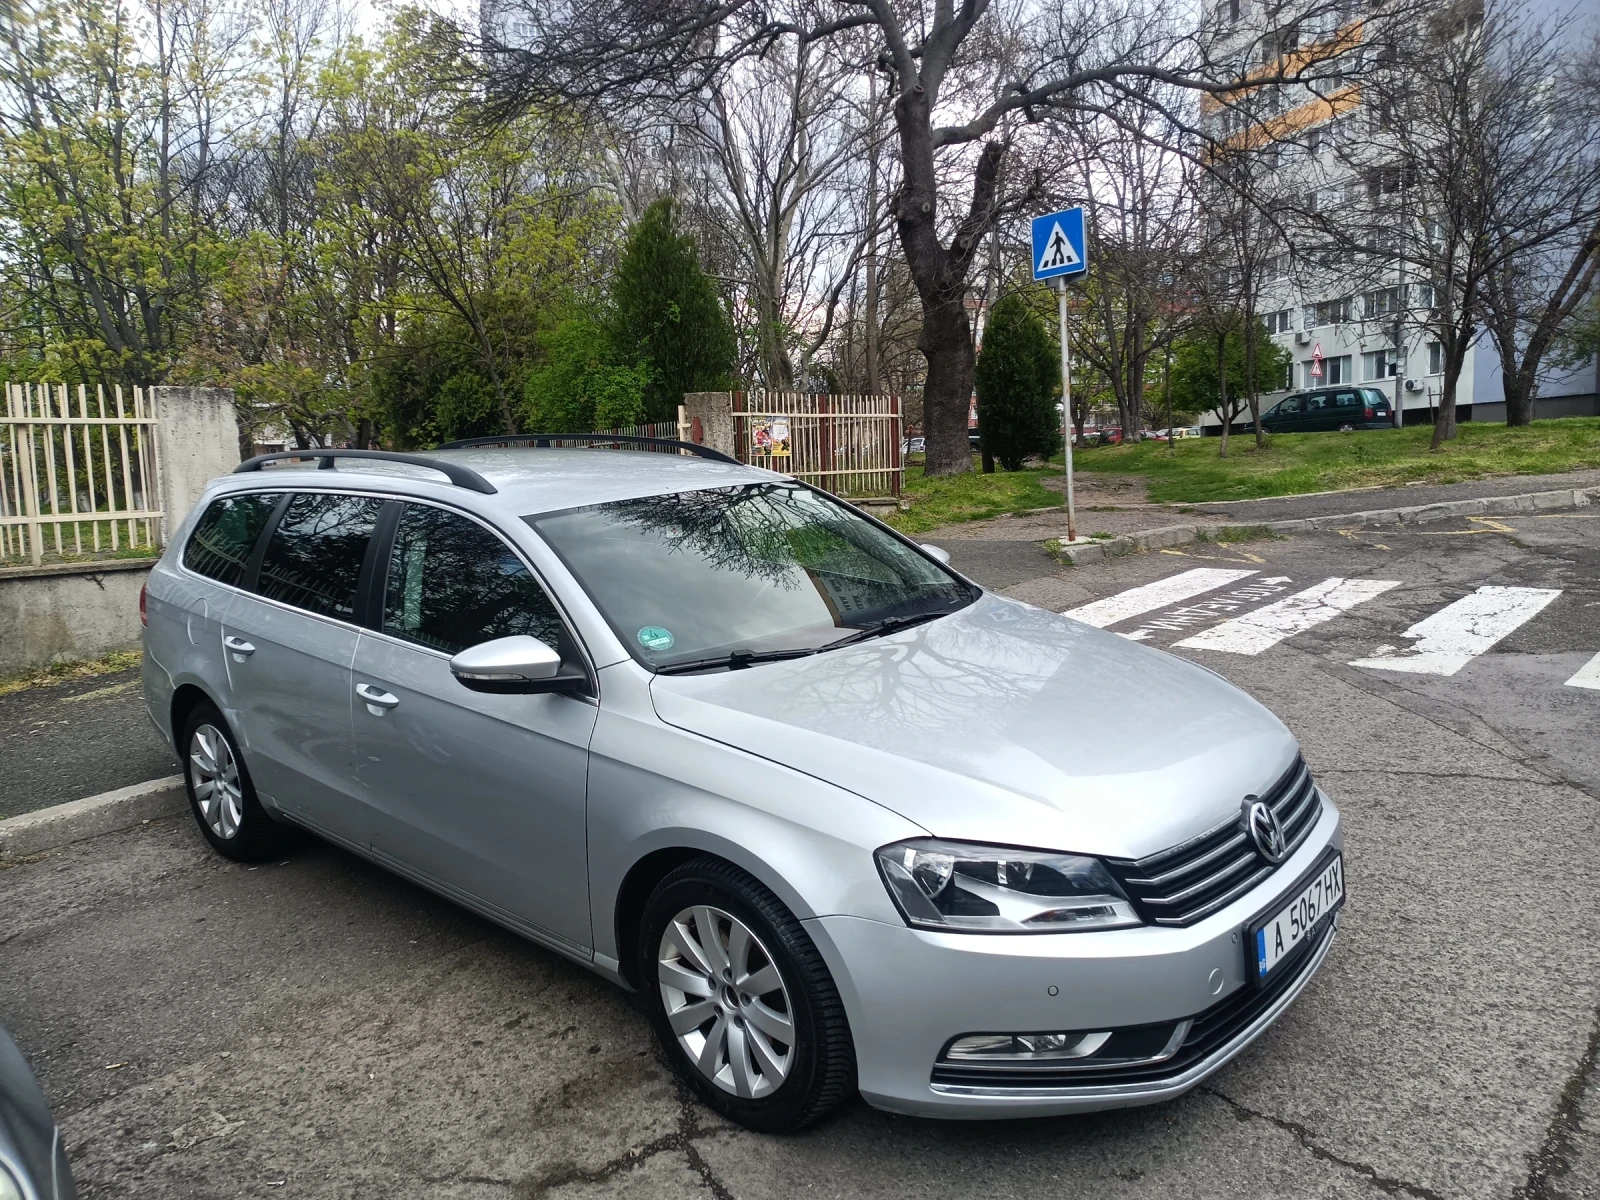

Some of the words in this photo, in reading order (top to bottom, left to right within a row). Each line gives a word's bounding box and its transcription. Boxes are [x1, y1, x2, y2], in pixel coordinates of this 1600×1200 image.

[1139, 584, 1287, 631] ПОГЛЕДНИ
[1274, 921, 1284, 958] A
[1290, 879, 1322, 941] 5067
[1323, 861, 1341, 907] HX
[1259, 958, 1266, 973] BG
